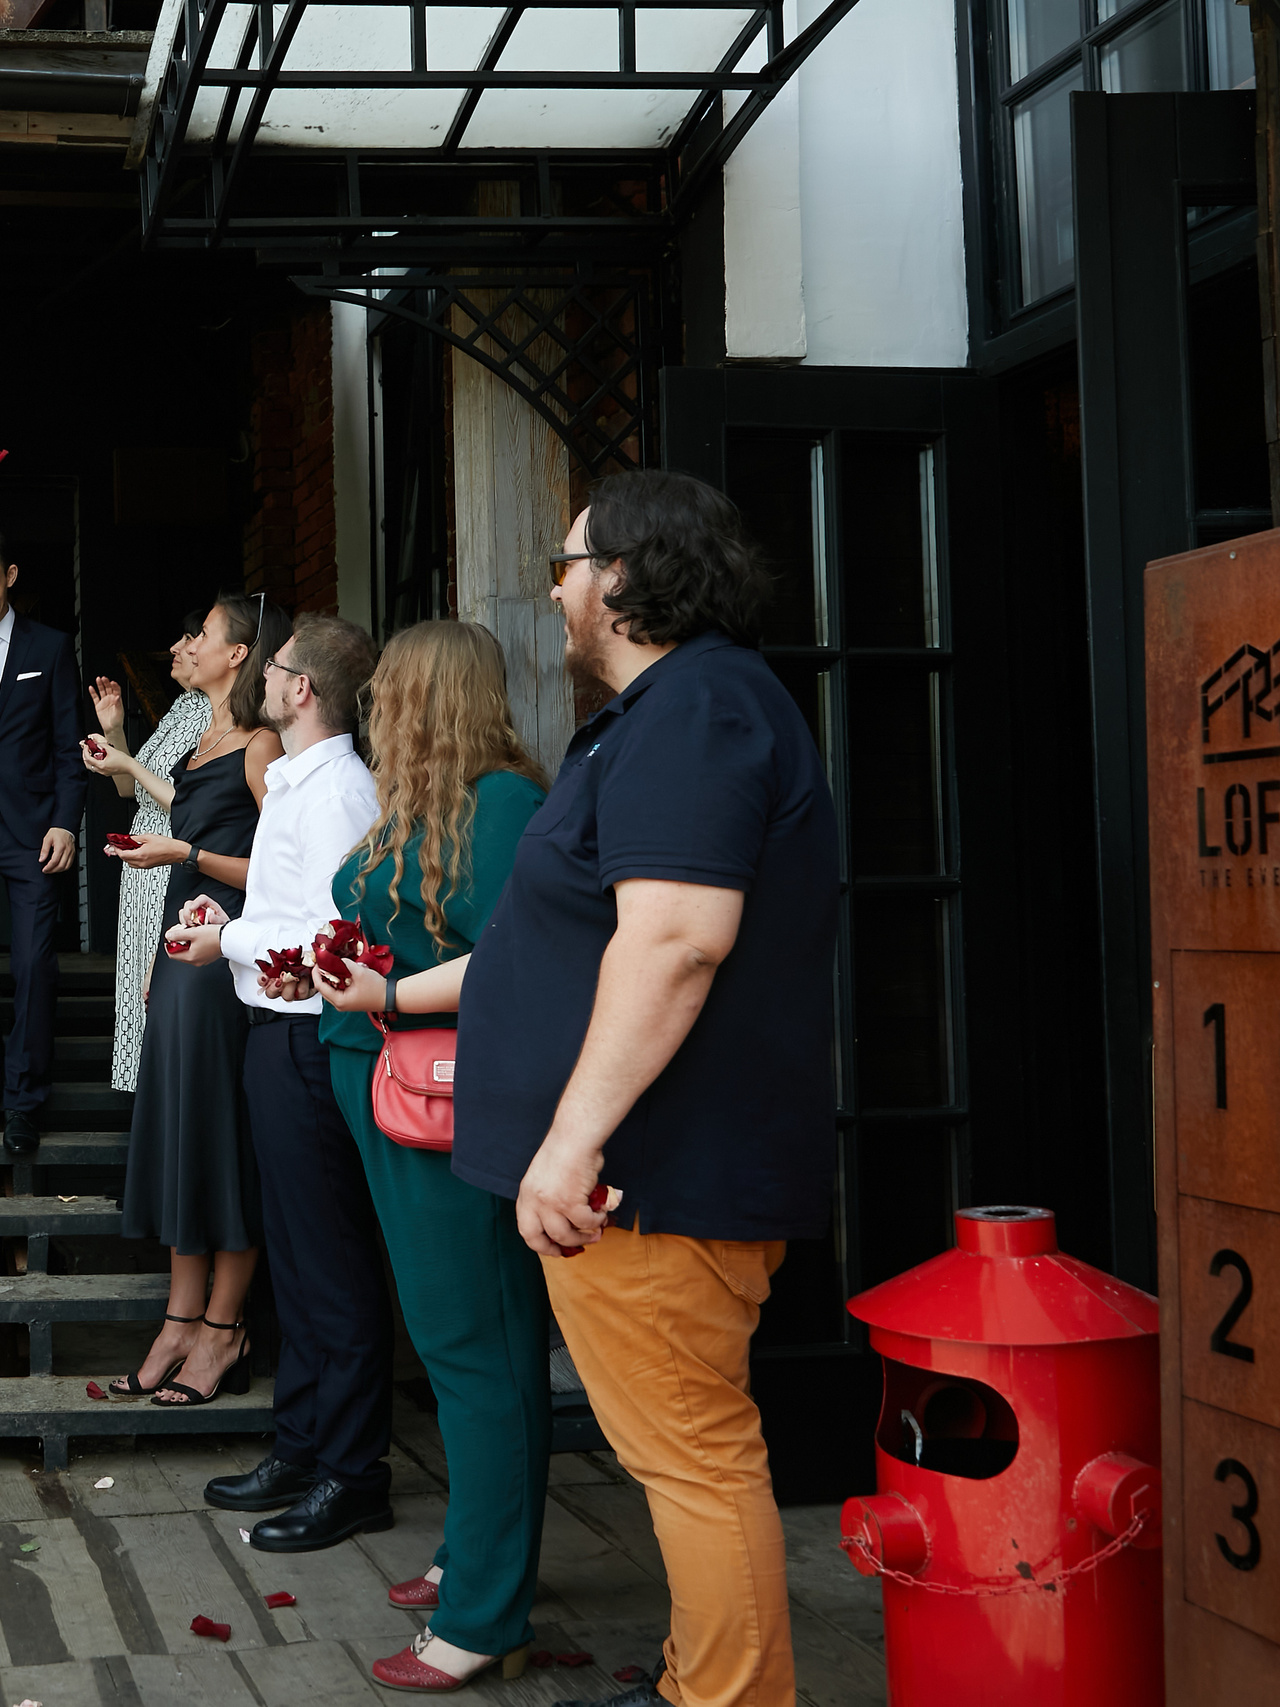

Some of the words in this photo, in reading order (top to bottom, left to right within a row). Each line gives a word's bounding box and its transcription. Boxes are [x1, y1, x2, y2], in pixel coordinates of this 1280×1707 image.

[1200, 867, 1232, 888] THE
[1203, 1003, 1228, 1110] 1
[1208, 1248, 1256, 1364] 2
[1214, 1457, 1262, 1572] 3
